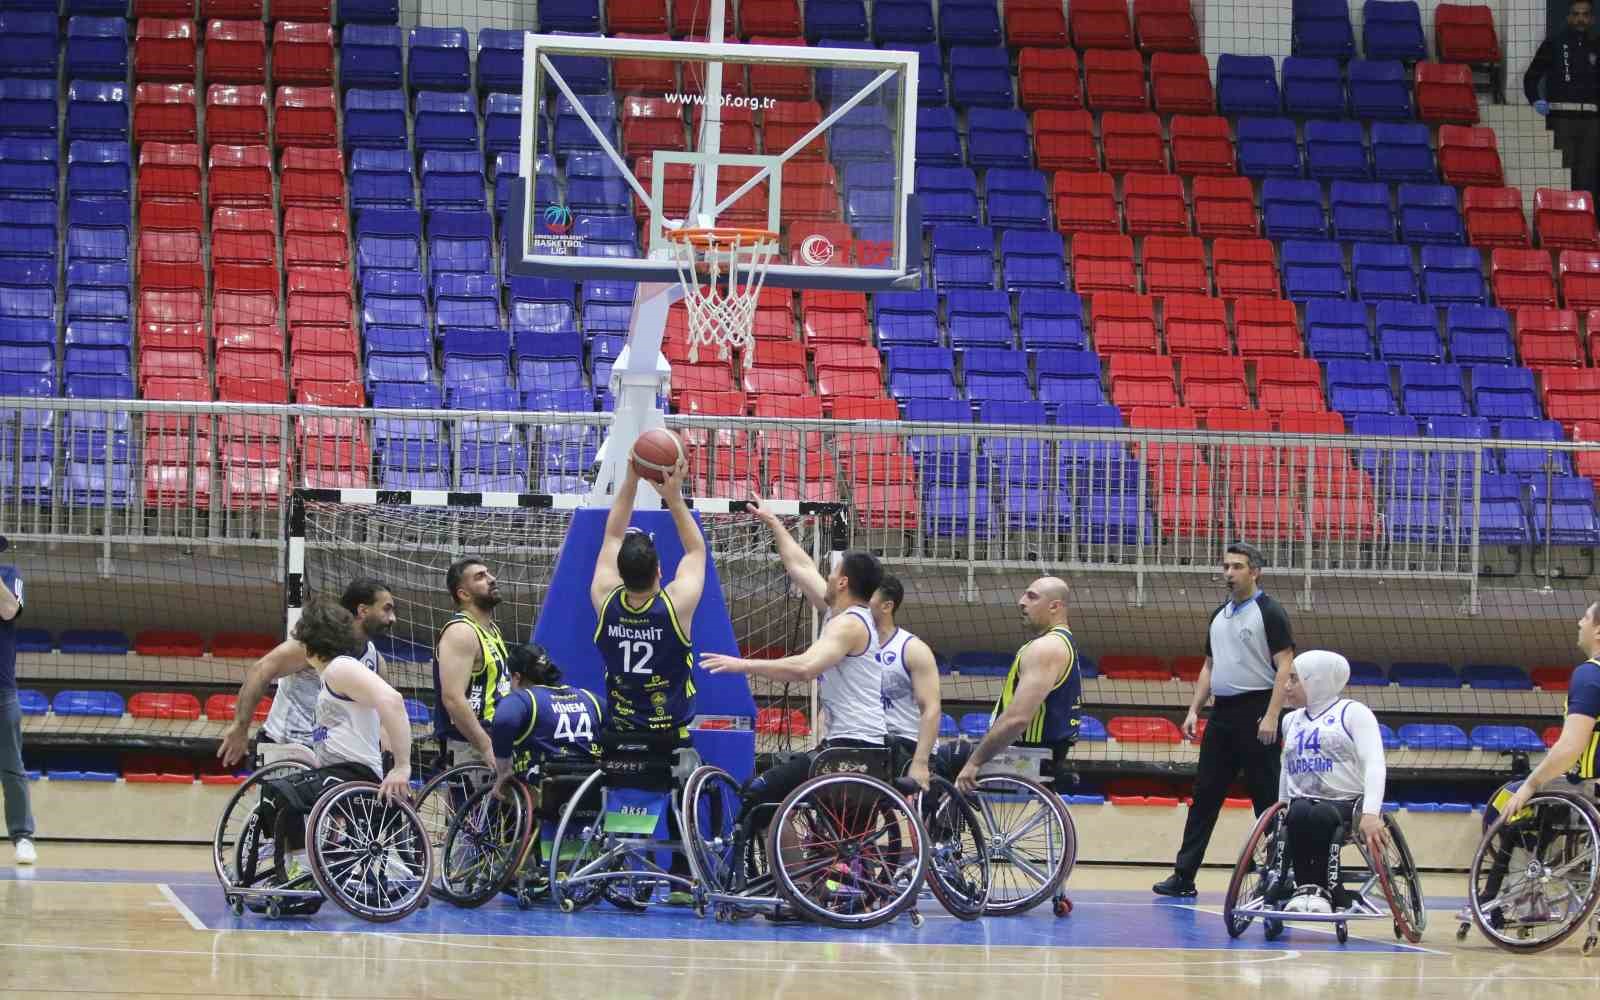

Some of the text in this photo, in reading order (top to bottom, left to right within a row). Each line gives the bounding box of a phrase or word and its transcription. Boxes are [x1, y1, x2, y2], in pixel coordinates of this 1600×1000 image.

[608, 624, 663, 640] MÜCAHİT
[618, 640, 654, 674] 12
[553, 713, 594, 742] 44
[1295, 727, 1321, 757] 14
[620, 805, 648, 815] aksa
[1328, 843, 1340, 890] EXTRA
